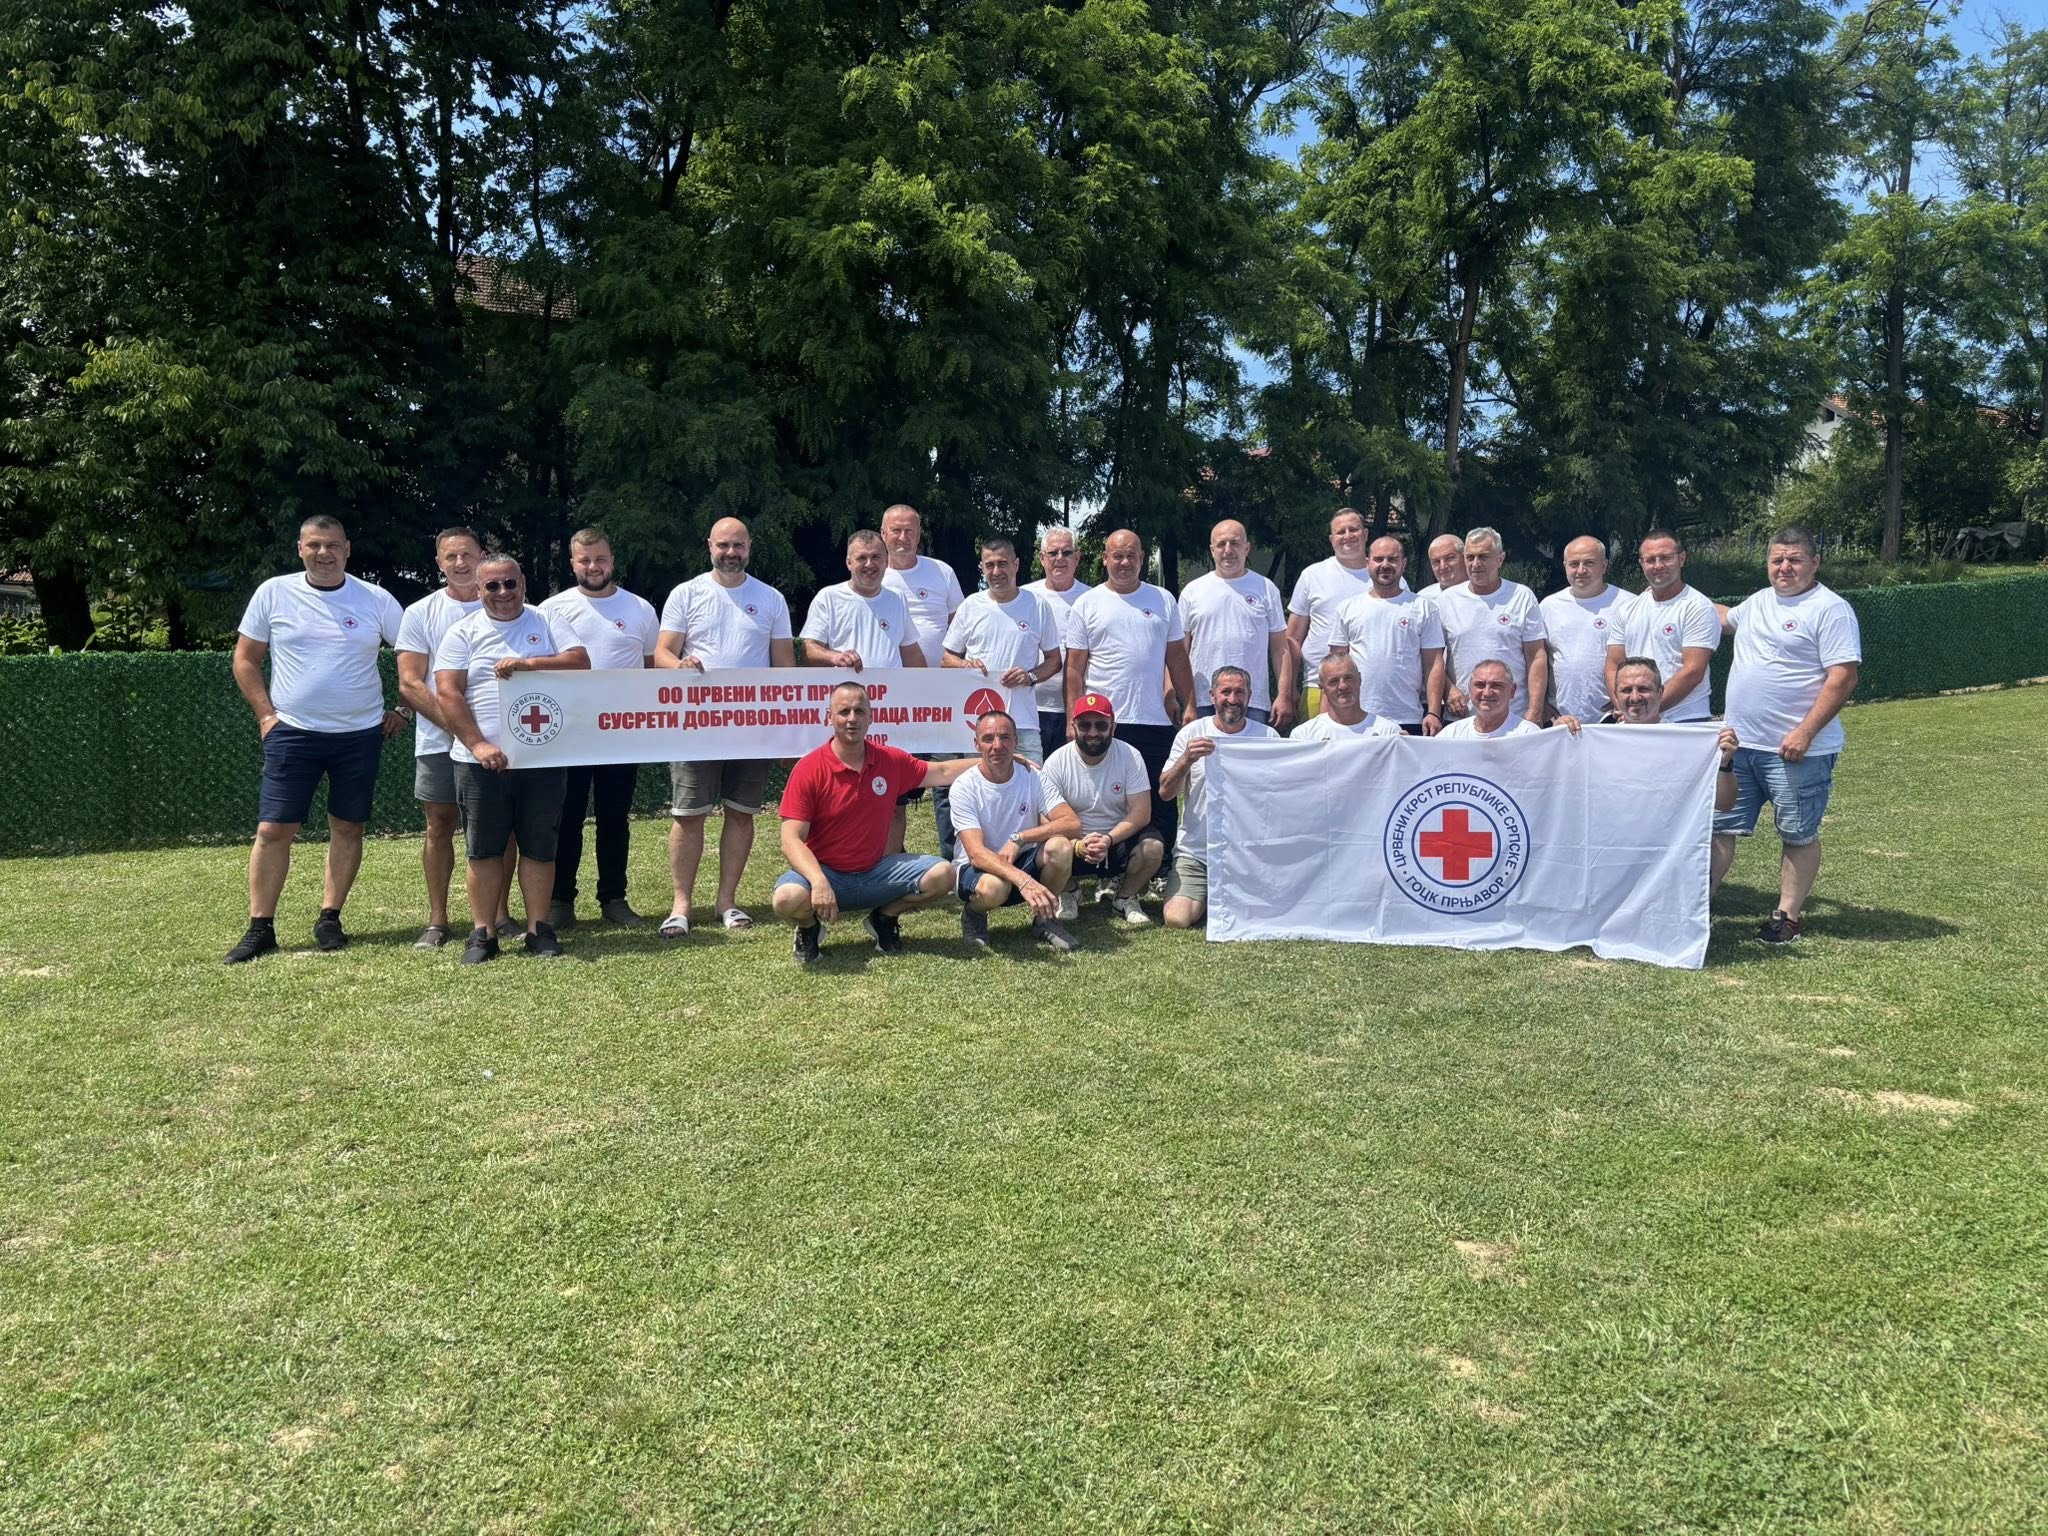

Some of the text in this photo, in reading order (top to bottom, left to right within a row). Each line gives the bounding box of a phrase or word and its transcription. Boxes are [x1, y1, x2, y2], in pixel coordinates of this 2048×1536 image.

[511, 694, 559, 714] ЦРВЕНИ КРСТ
[658, 684, 887, 705] ОО ЦРВЕНИ КРСТ ПРОР
[598, 711, 679, 730] СУСРЕТИ
[682, 708, 821, 730] ДОБРОВОЉНИХ
[912, 706, 952, 723] КРВИ
[513, 722, 559, 743] ПРЊАВОР
[1392, 782, 1521, 870] ЦРВЕНИ КРСТ РЕПУБЛИКЕ СРПСКЕ
[1405, 875, 1507, 908] ГОЦК ПРЊАВОР
